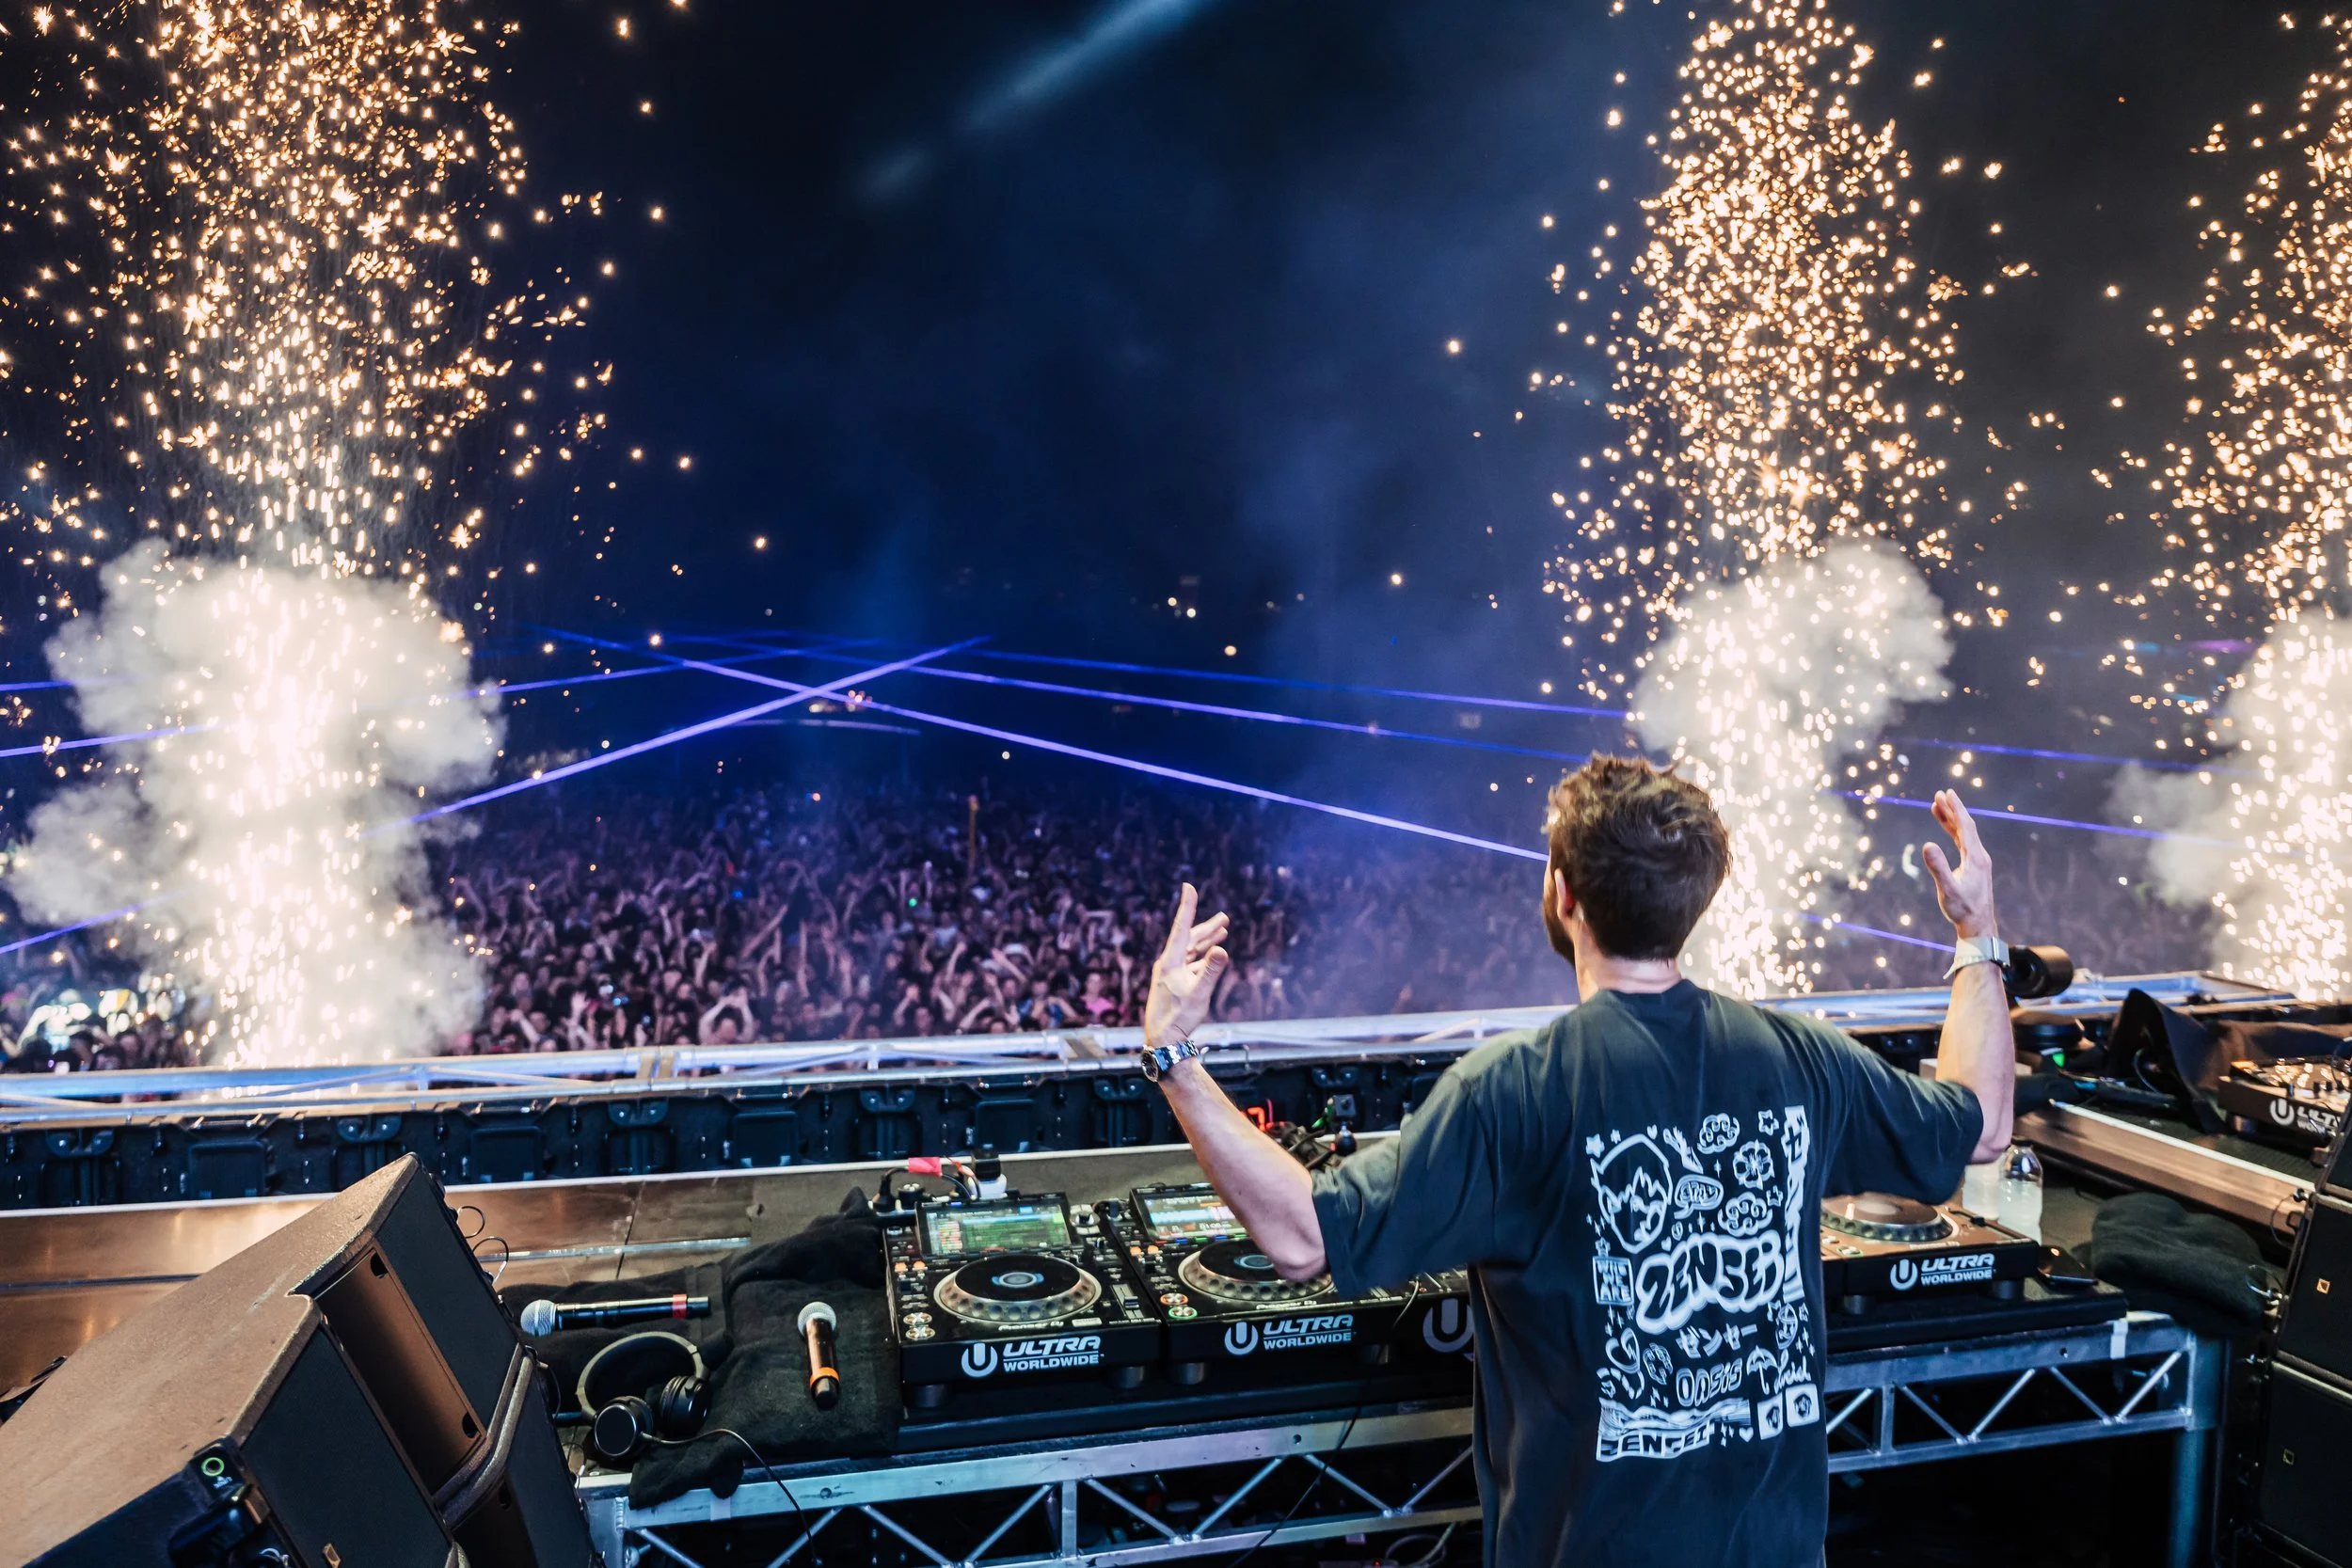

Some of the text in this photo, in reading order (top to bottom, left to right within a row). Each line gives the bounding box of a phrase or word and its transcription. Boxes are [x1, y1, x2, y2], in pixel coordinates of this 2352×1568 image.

[1921, 1253, 1995, 1272] ULTRA
[1920, 1269, 1993, 1287] WORLDWIDE
[1263, 1314, 1354, 1336] ULTRA
[1003, 1336, 1102, 1356] ULTRA
[1263, 1332, 1352, 1350] WORLDWIDE
[1003, 1354, 1100, 1372] WORLDWIDE
